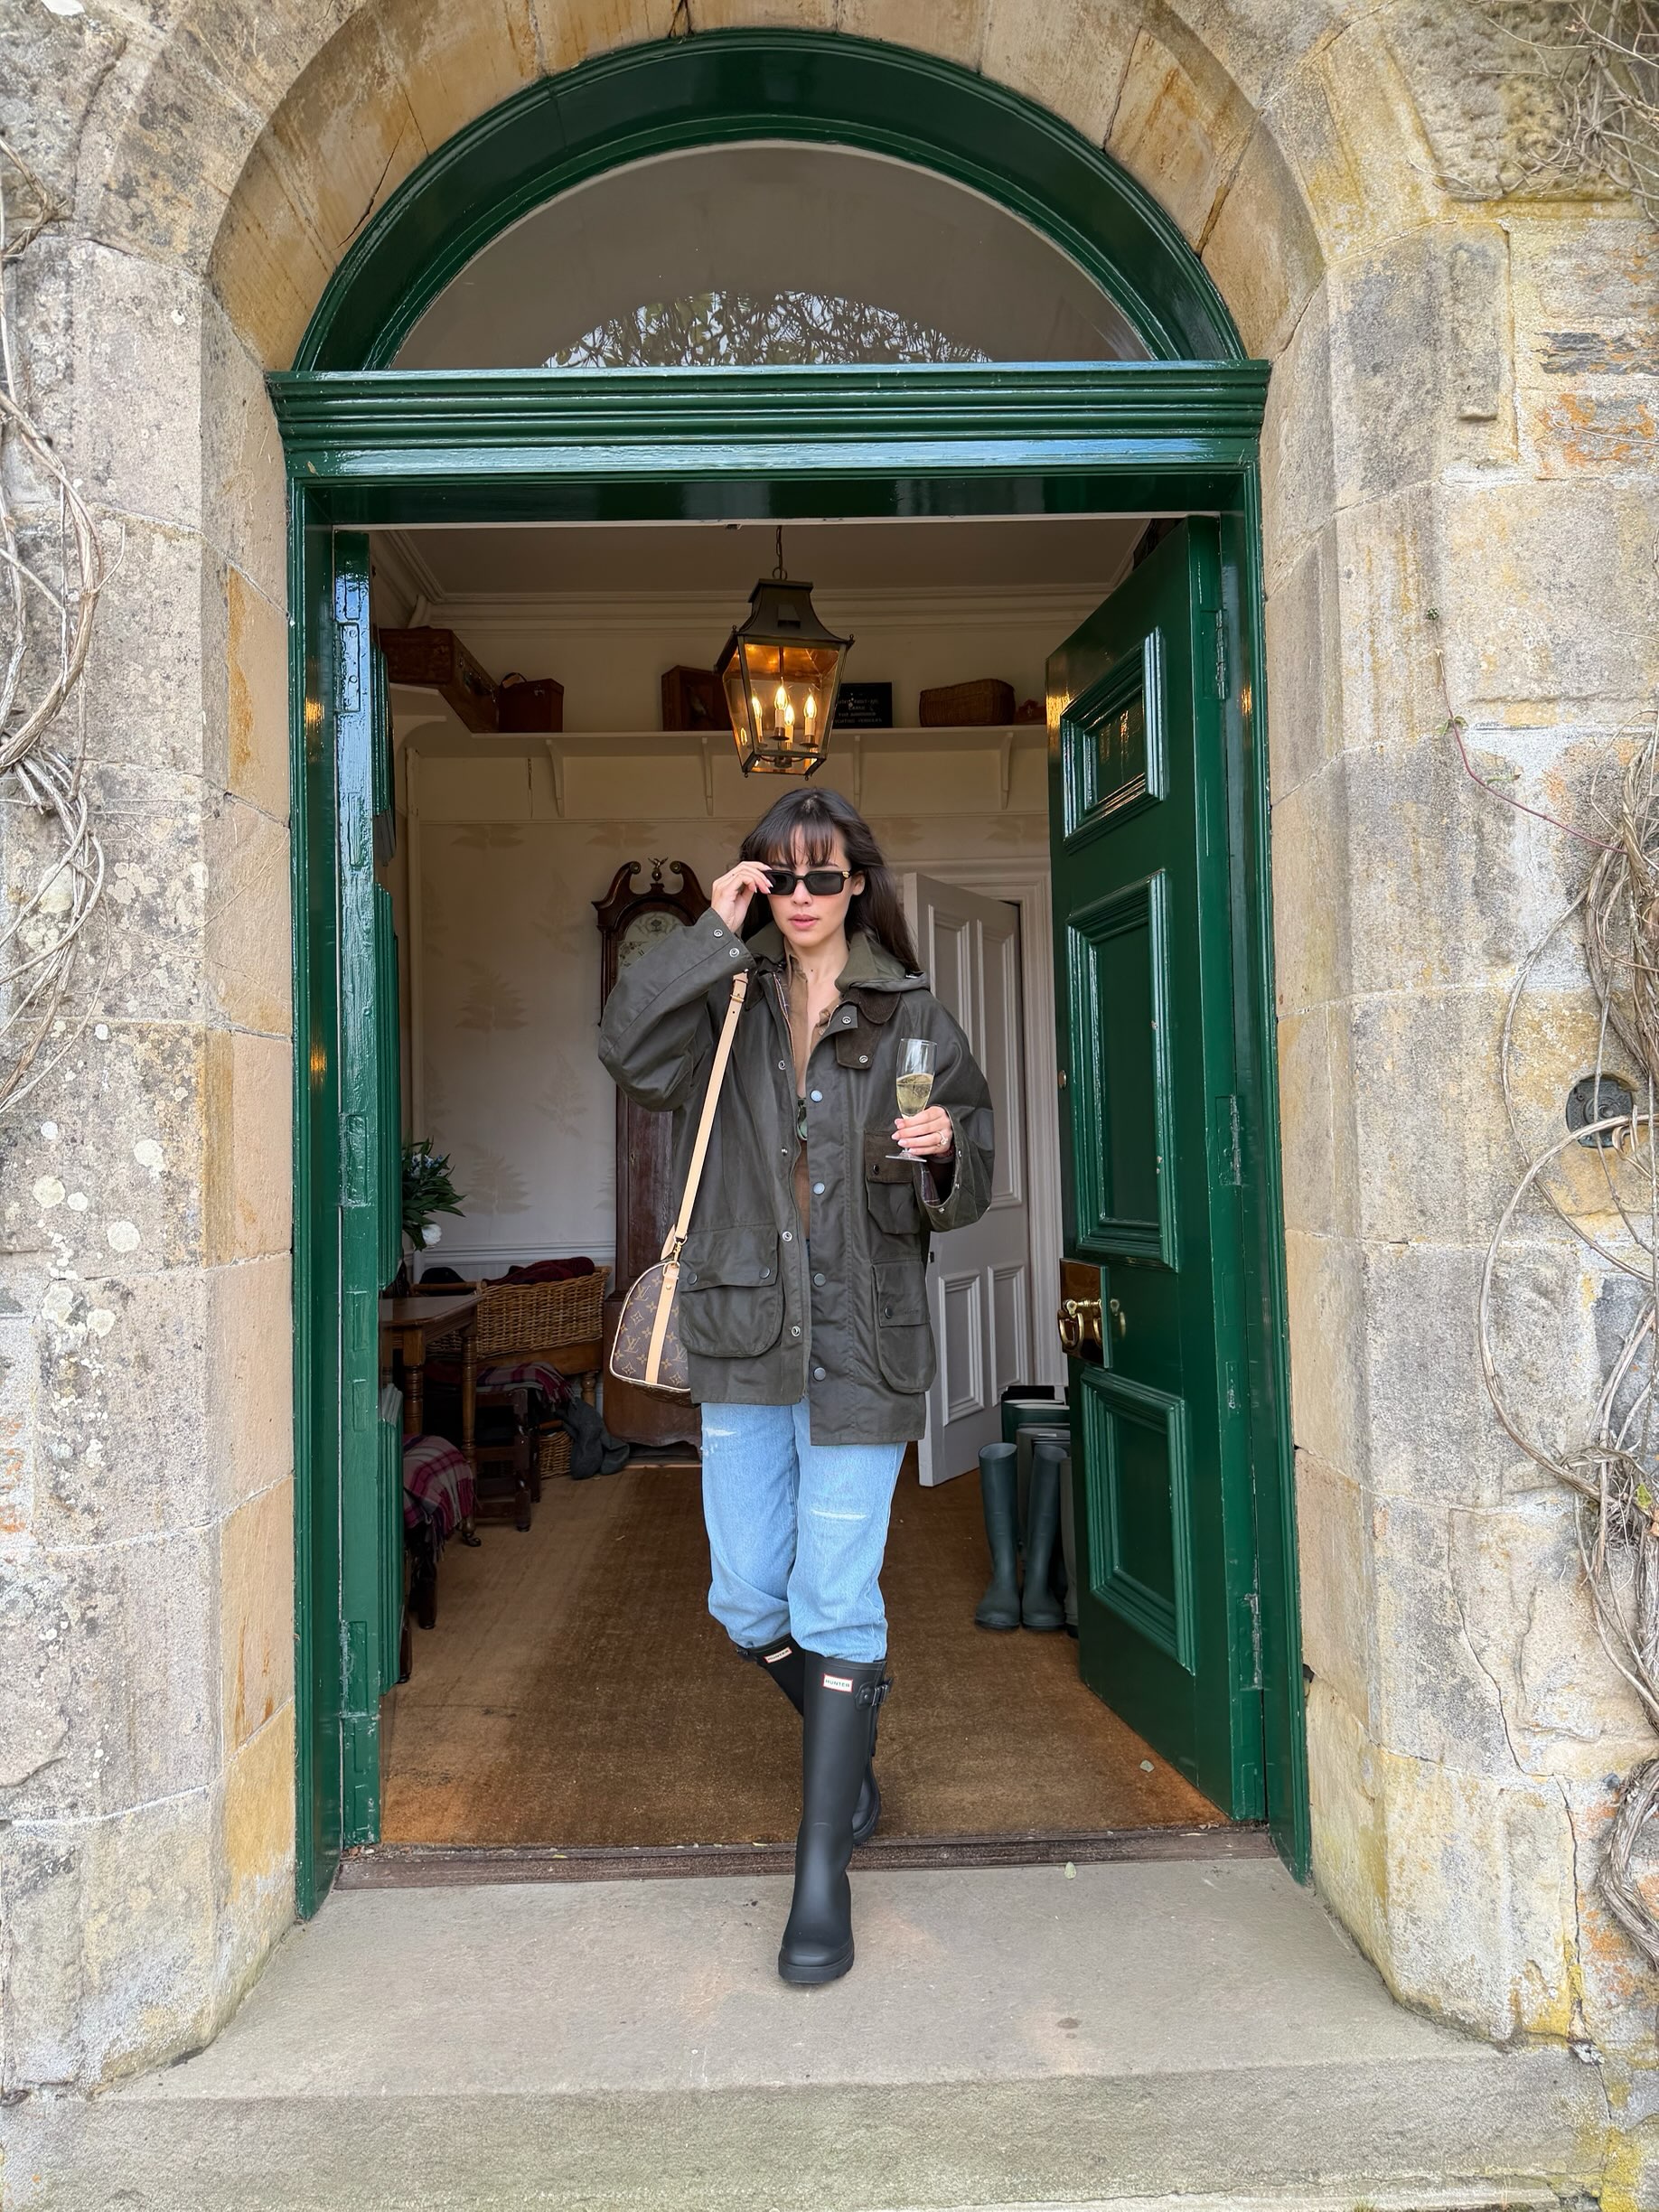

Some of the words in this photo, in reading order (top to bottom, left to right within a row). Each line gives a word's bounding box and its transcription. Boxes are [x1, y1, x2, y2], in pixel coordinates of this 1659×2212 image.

[624, 1335, 641, 1353] LV
[767, 1649, 790, 1661] HUNTER
[825, 1679, 850, 1688] HUNTER
